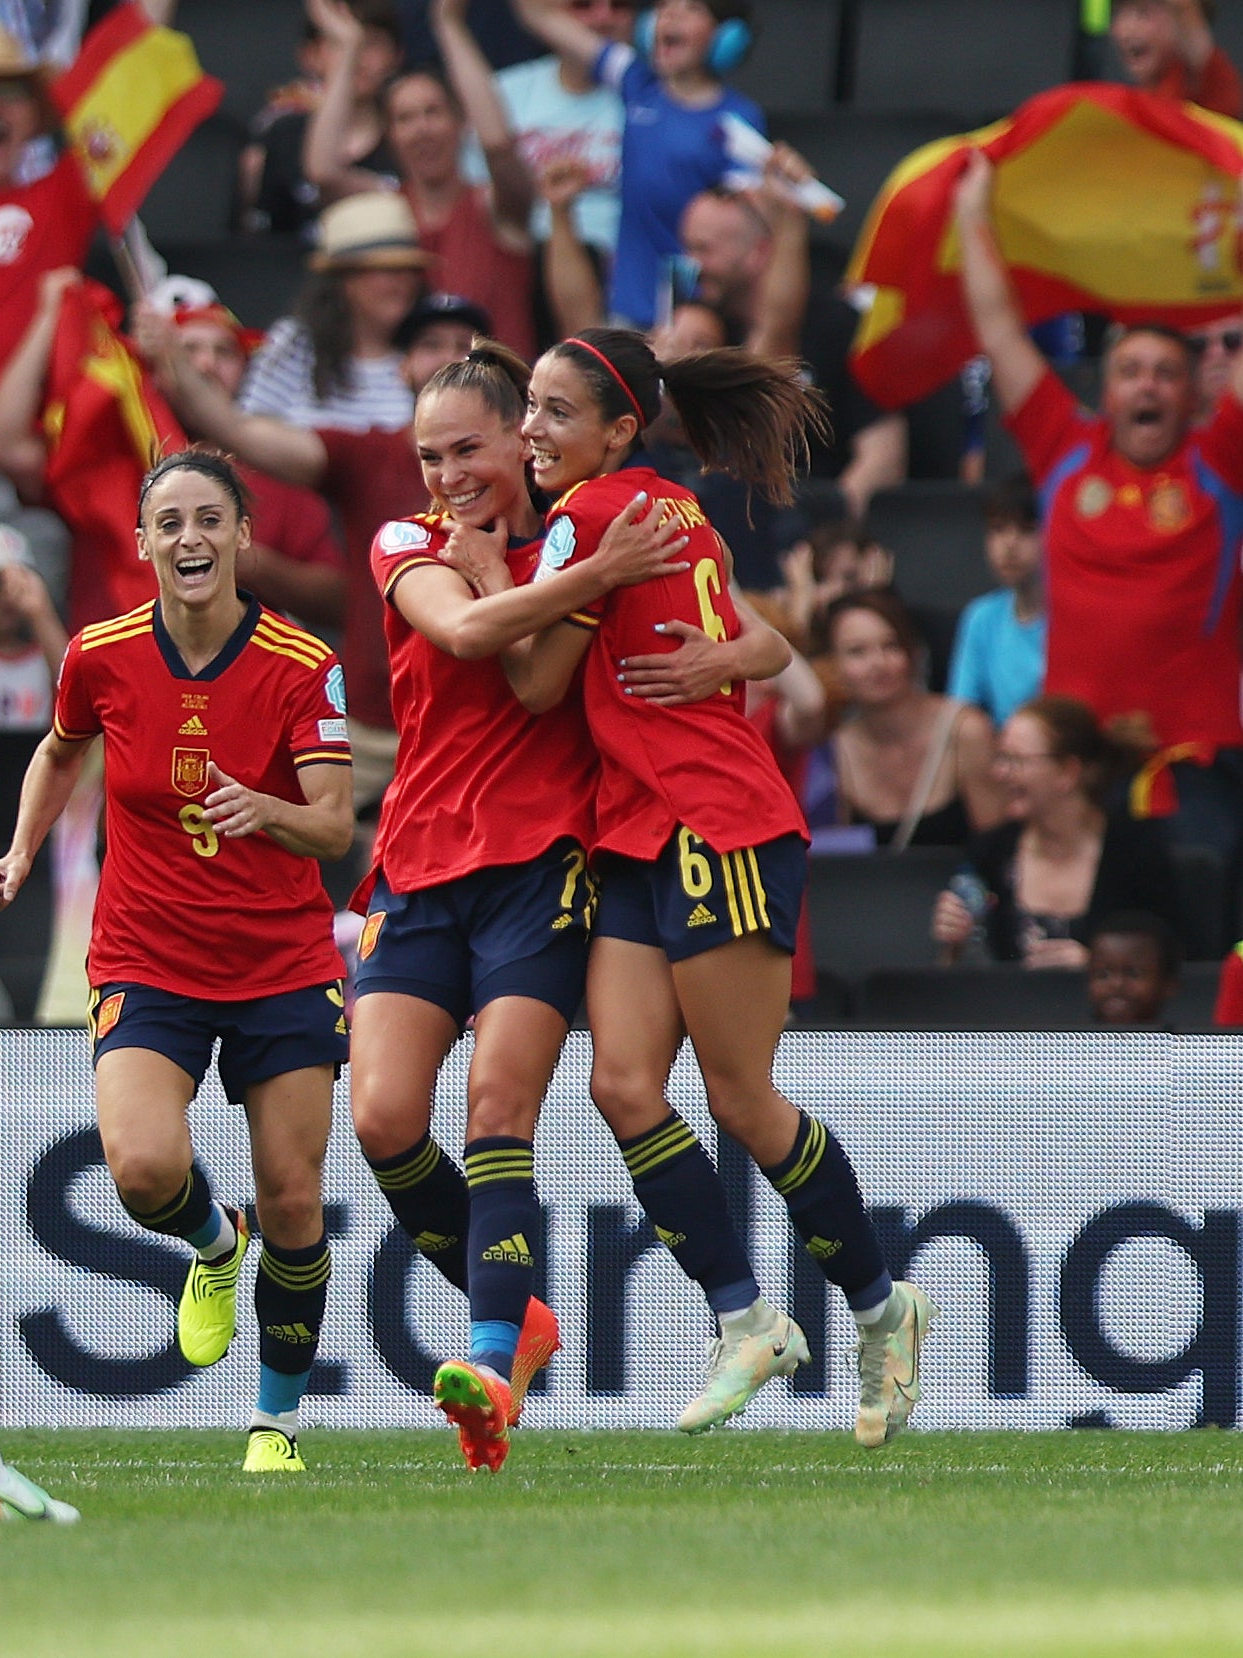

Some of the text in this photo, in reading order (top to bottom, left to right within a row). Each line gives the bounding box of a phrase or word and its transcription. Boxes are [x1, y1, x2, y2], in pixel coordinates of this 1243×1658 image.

[178, 727, 209, 736] adidas
[178, 804, 219, 858] 9
[679, 826, 713, 898] 6
[561, 849, 586, 908] 7
[687, 914, 717, 927] adidas
[482, 1248, 534, 1267] adidas
[266, 1325, 318, 1344] adidas
